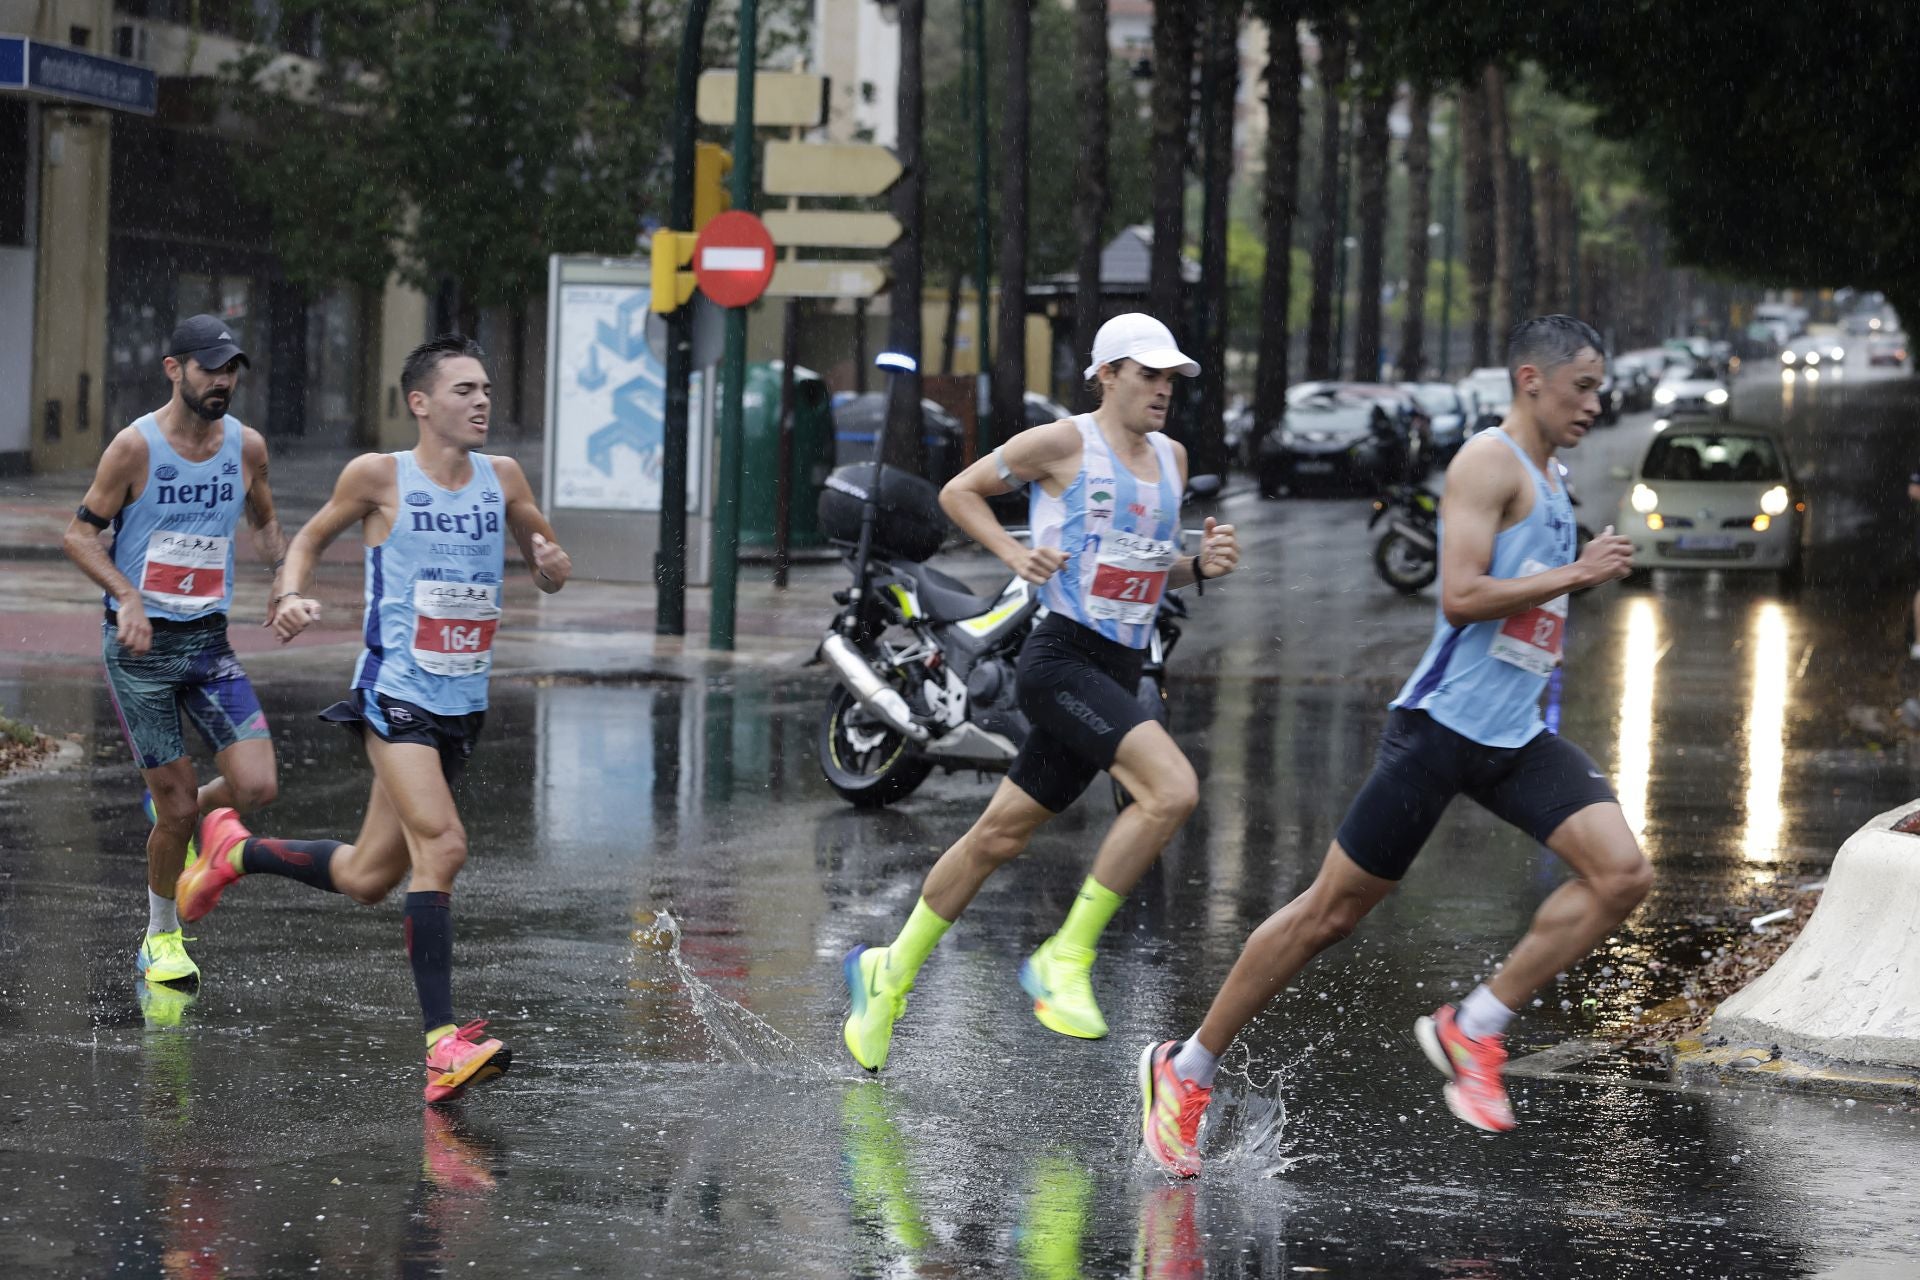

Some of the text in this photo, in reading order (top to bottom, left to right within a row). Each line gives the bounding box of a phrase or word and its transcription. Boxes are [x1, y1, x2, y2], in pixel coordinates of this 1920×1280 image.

[157, 476, 235, 509] nerja
[411, 504, 498, 541] nerja
[428, 543, 491, 556] ATLETISMO
[177, 573, 195, 594] 4
[1119, 577, 1151, 600] 21
[440, 625, 481, 651] 164
